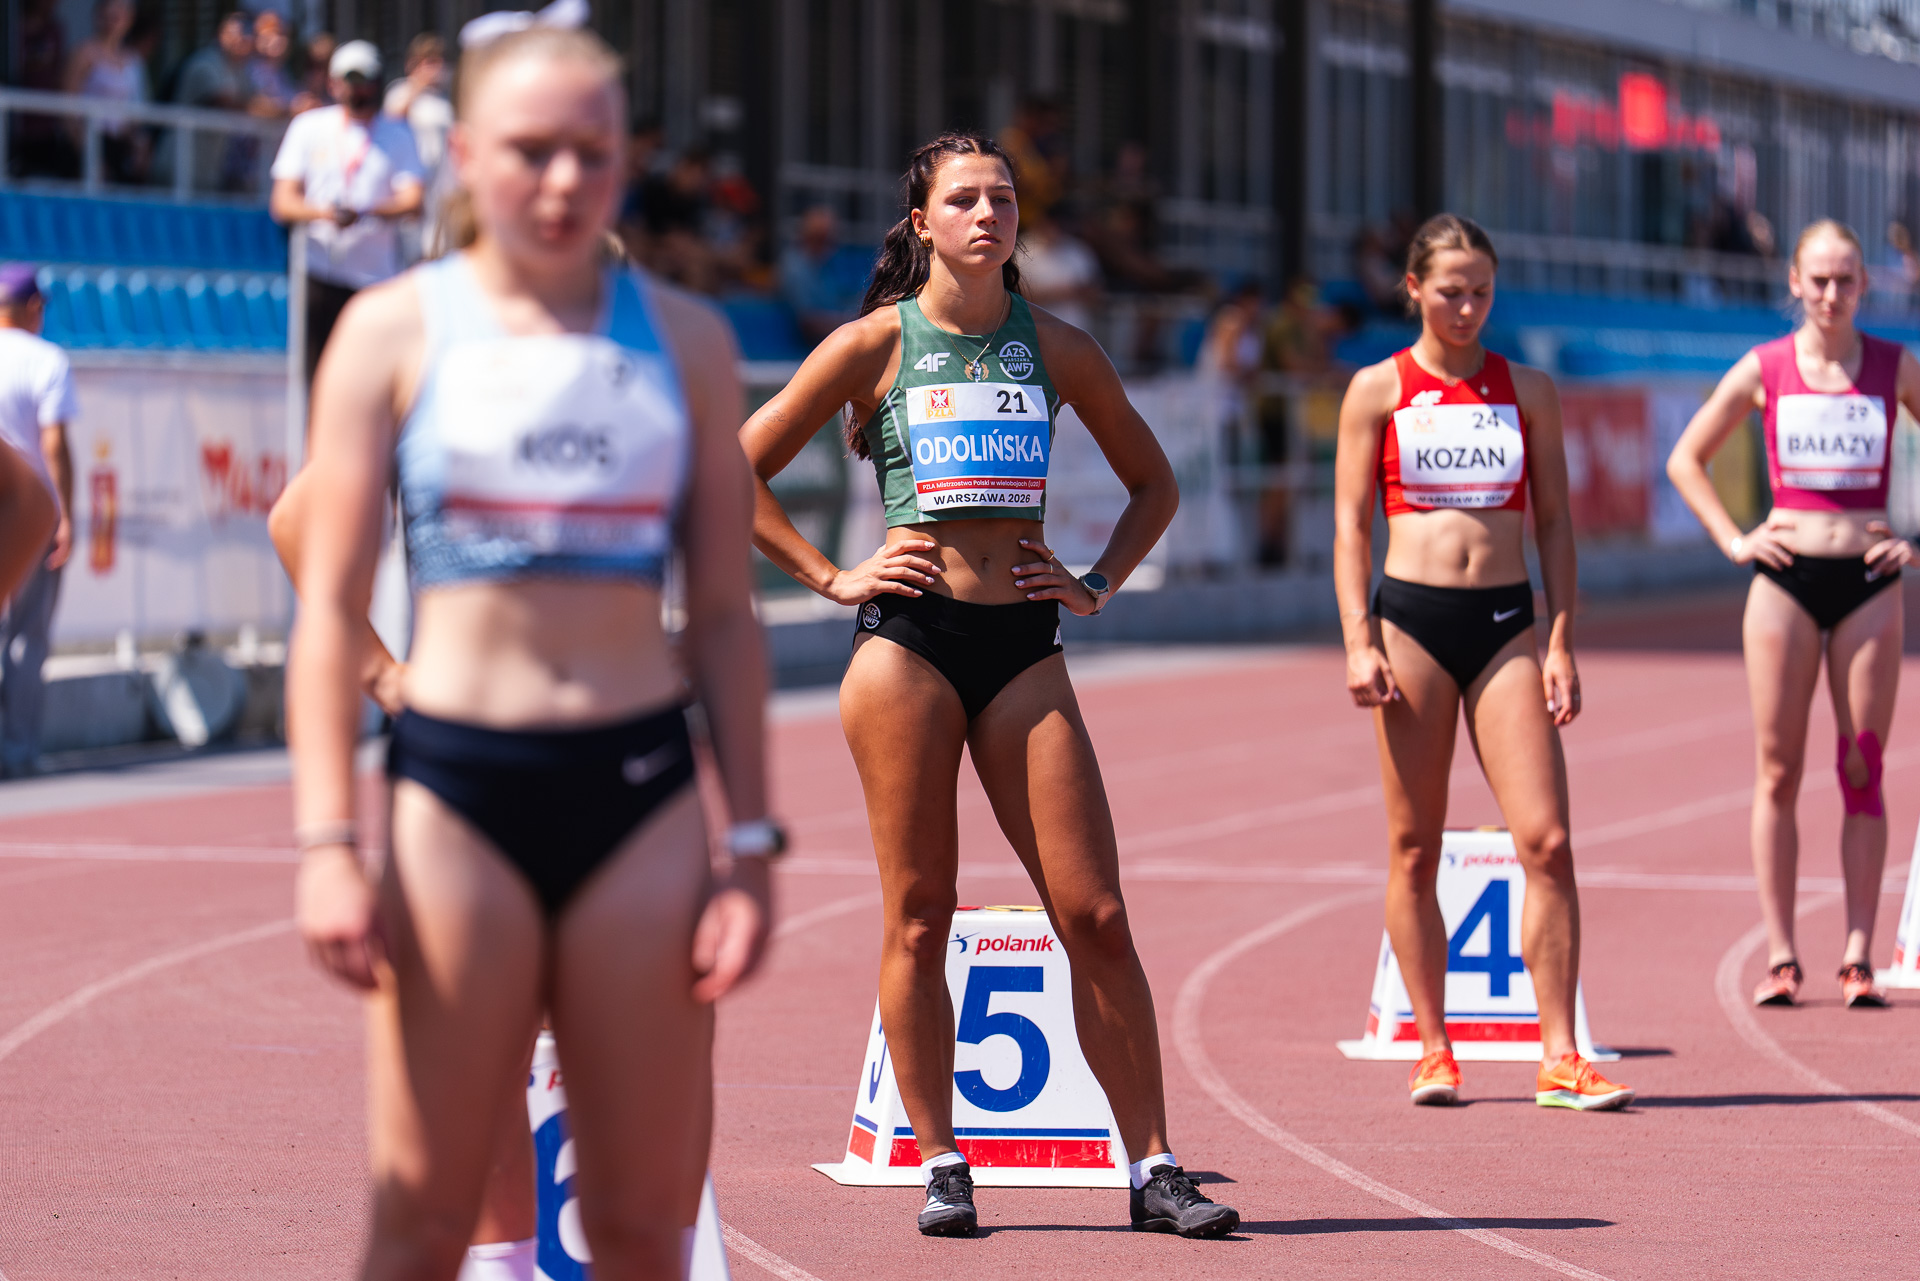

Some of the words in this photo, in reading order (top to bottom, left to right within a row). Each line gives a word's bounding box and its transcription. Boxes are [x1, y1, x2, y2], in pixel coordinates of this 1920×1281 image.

[913, 352, 950, 373] 4F
[1006, 347, 1026, 357] AZS
[1007, 362, 1029, 372] AWF
[996, 390, 1028, 414] 21
[927, 408, 954, 418] PZLA
[1472, 411, 1500, 429] 24
[915, 428, 1044, 465] ODOLIŃSKA
[1416, 447, 1506, 470] KOZAN
[936, 480, 972, 489] Mistrzostwa
[973, 479, 990, 487] Polski
[996, 480, 1027, 488] wielobojach
[933, 493, 1006, 505] WARSZAWA
[1007, 493, 1031, 503] 2026
[975, 933, 1055, 955] polanik
[1447, 879, 1524, 997] 4
[953, 965, 1051, 1113] 5
